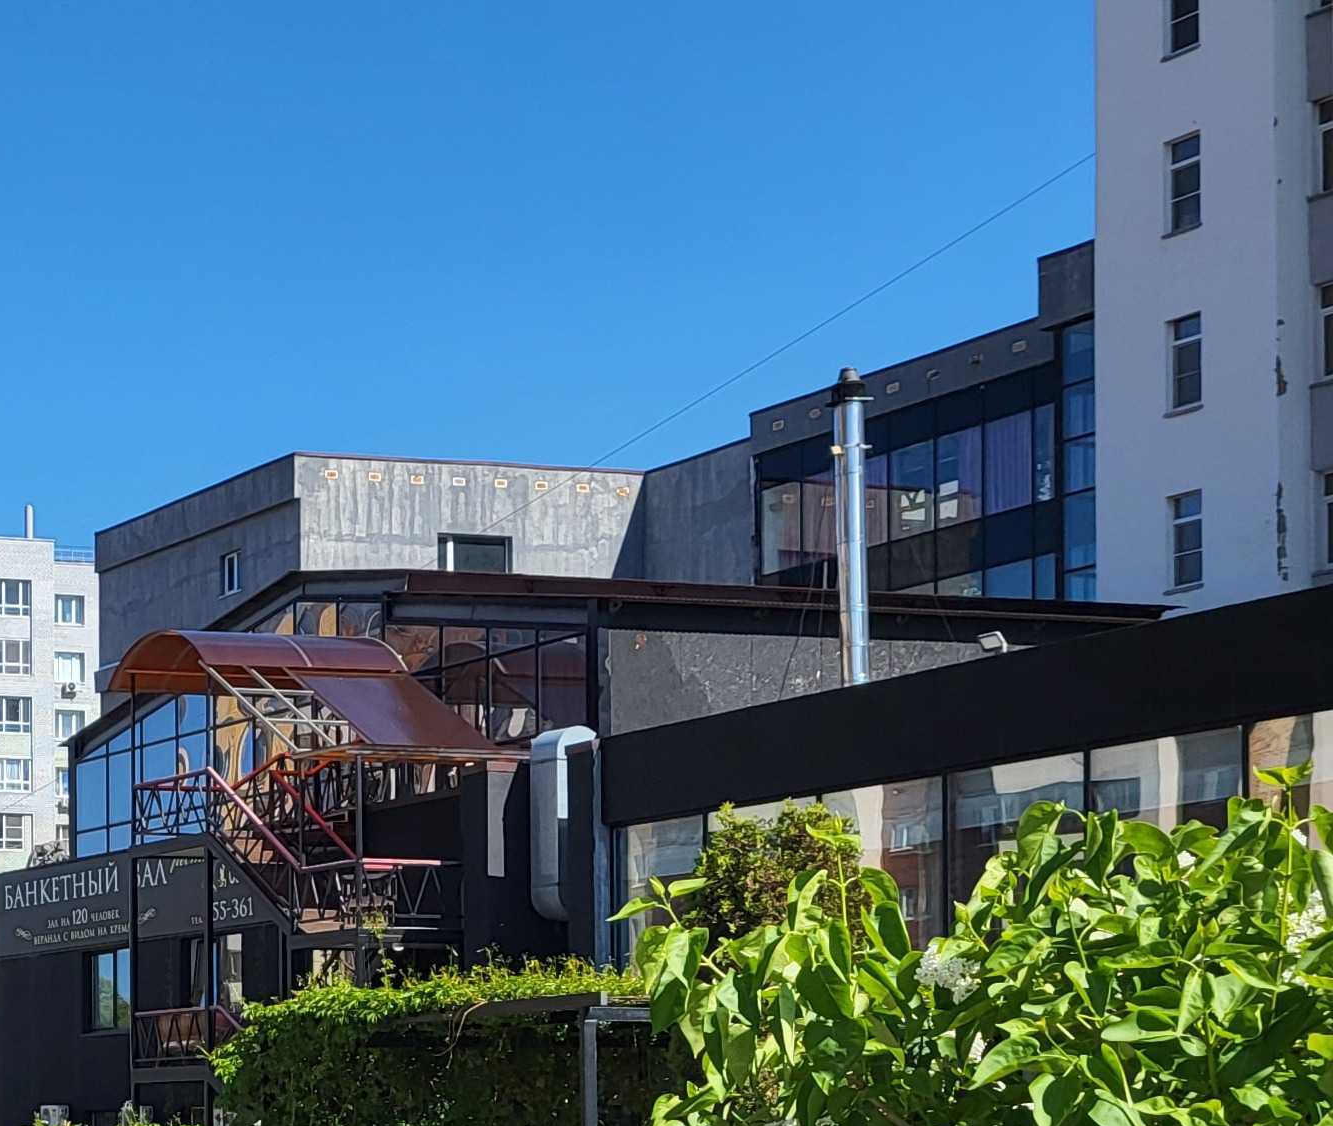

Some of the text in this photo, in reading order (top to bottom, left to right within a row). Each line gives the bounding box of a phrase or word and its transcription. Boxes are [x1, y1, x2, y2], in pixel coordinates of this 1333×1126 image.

[4, 861, 120, 910] БАНКЕТНЫЙ
[72, 908, 89, 924] 120
[213, 896, 254, 921] 55-361
